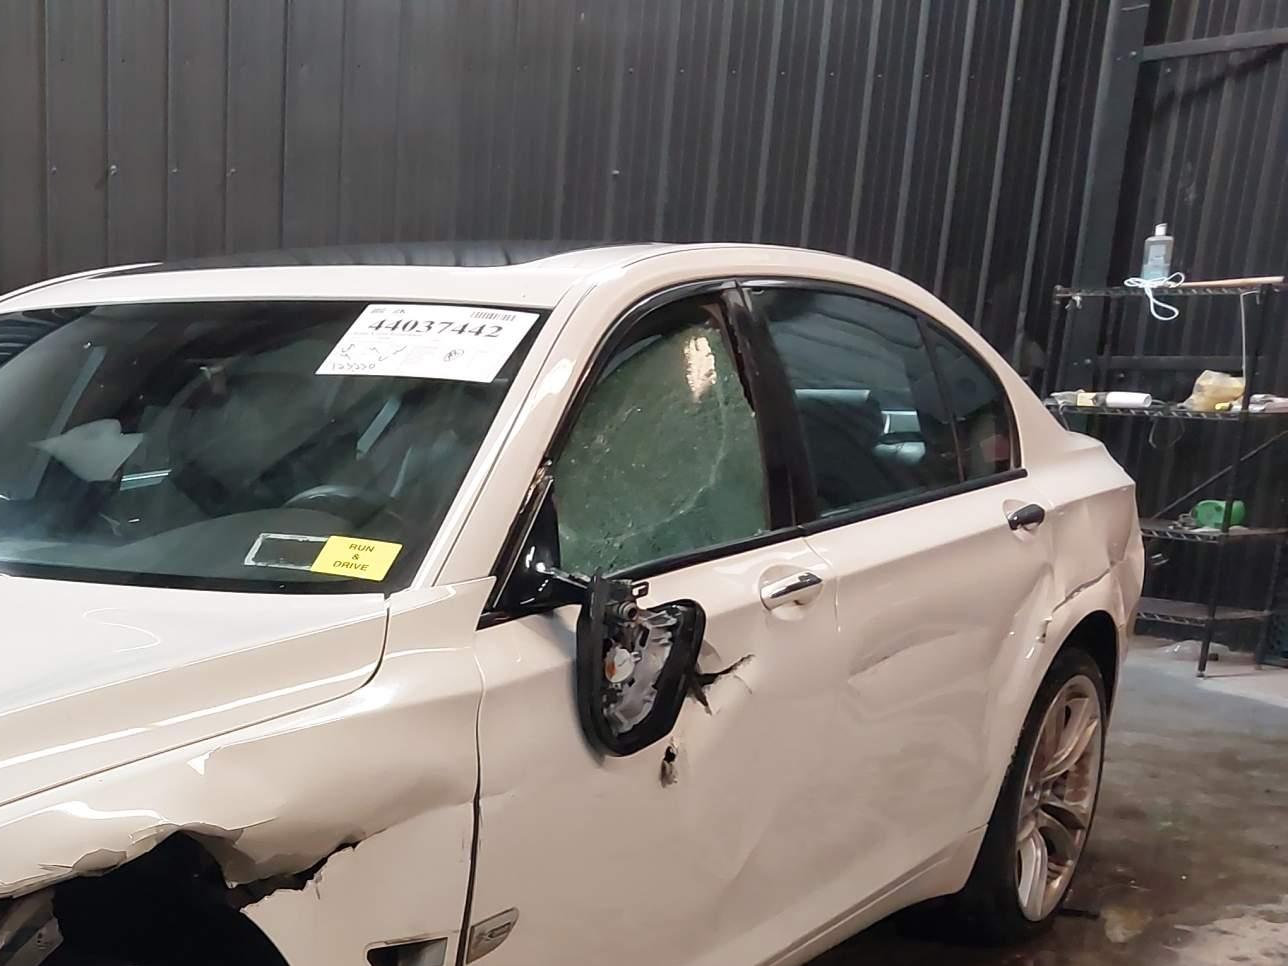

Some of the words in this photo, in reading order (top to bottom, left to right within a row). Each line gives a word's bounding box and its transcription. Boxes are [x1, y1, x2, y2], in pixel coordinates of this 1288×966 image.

[368, 318, 504, 338] 44037442
[348, 543, 375, 552] RUN
[332, 560, 369, 571] DRIVE
